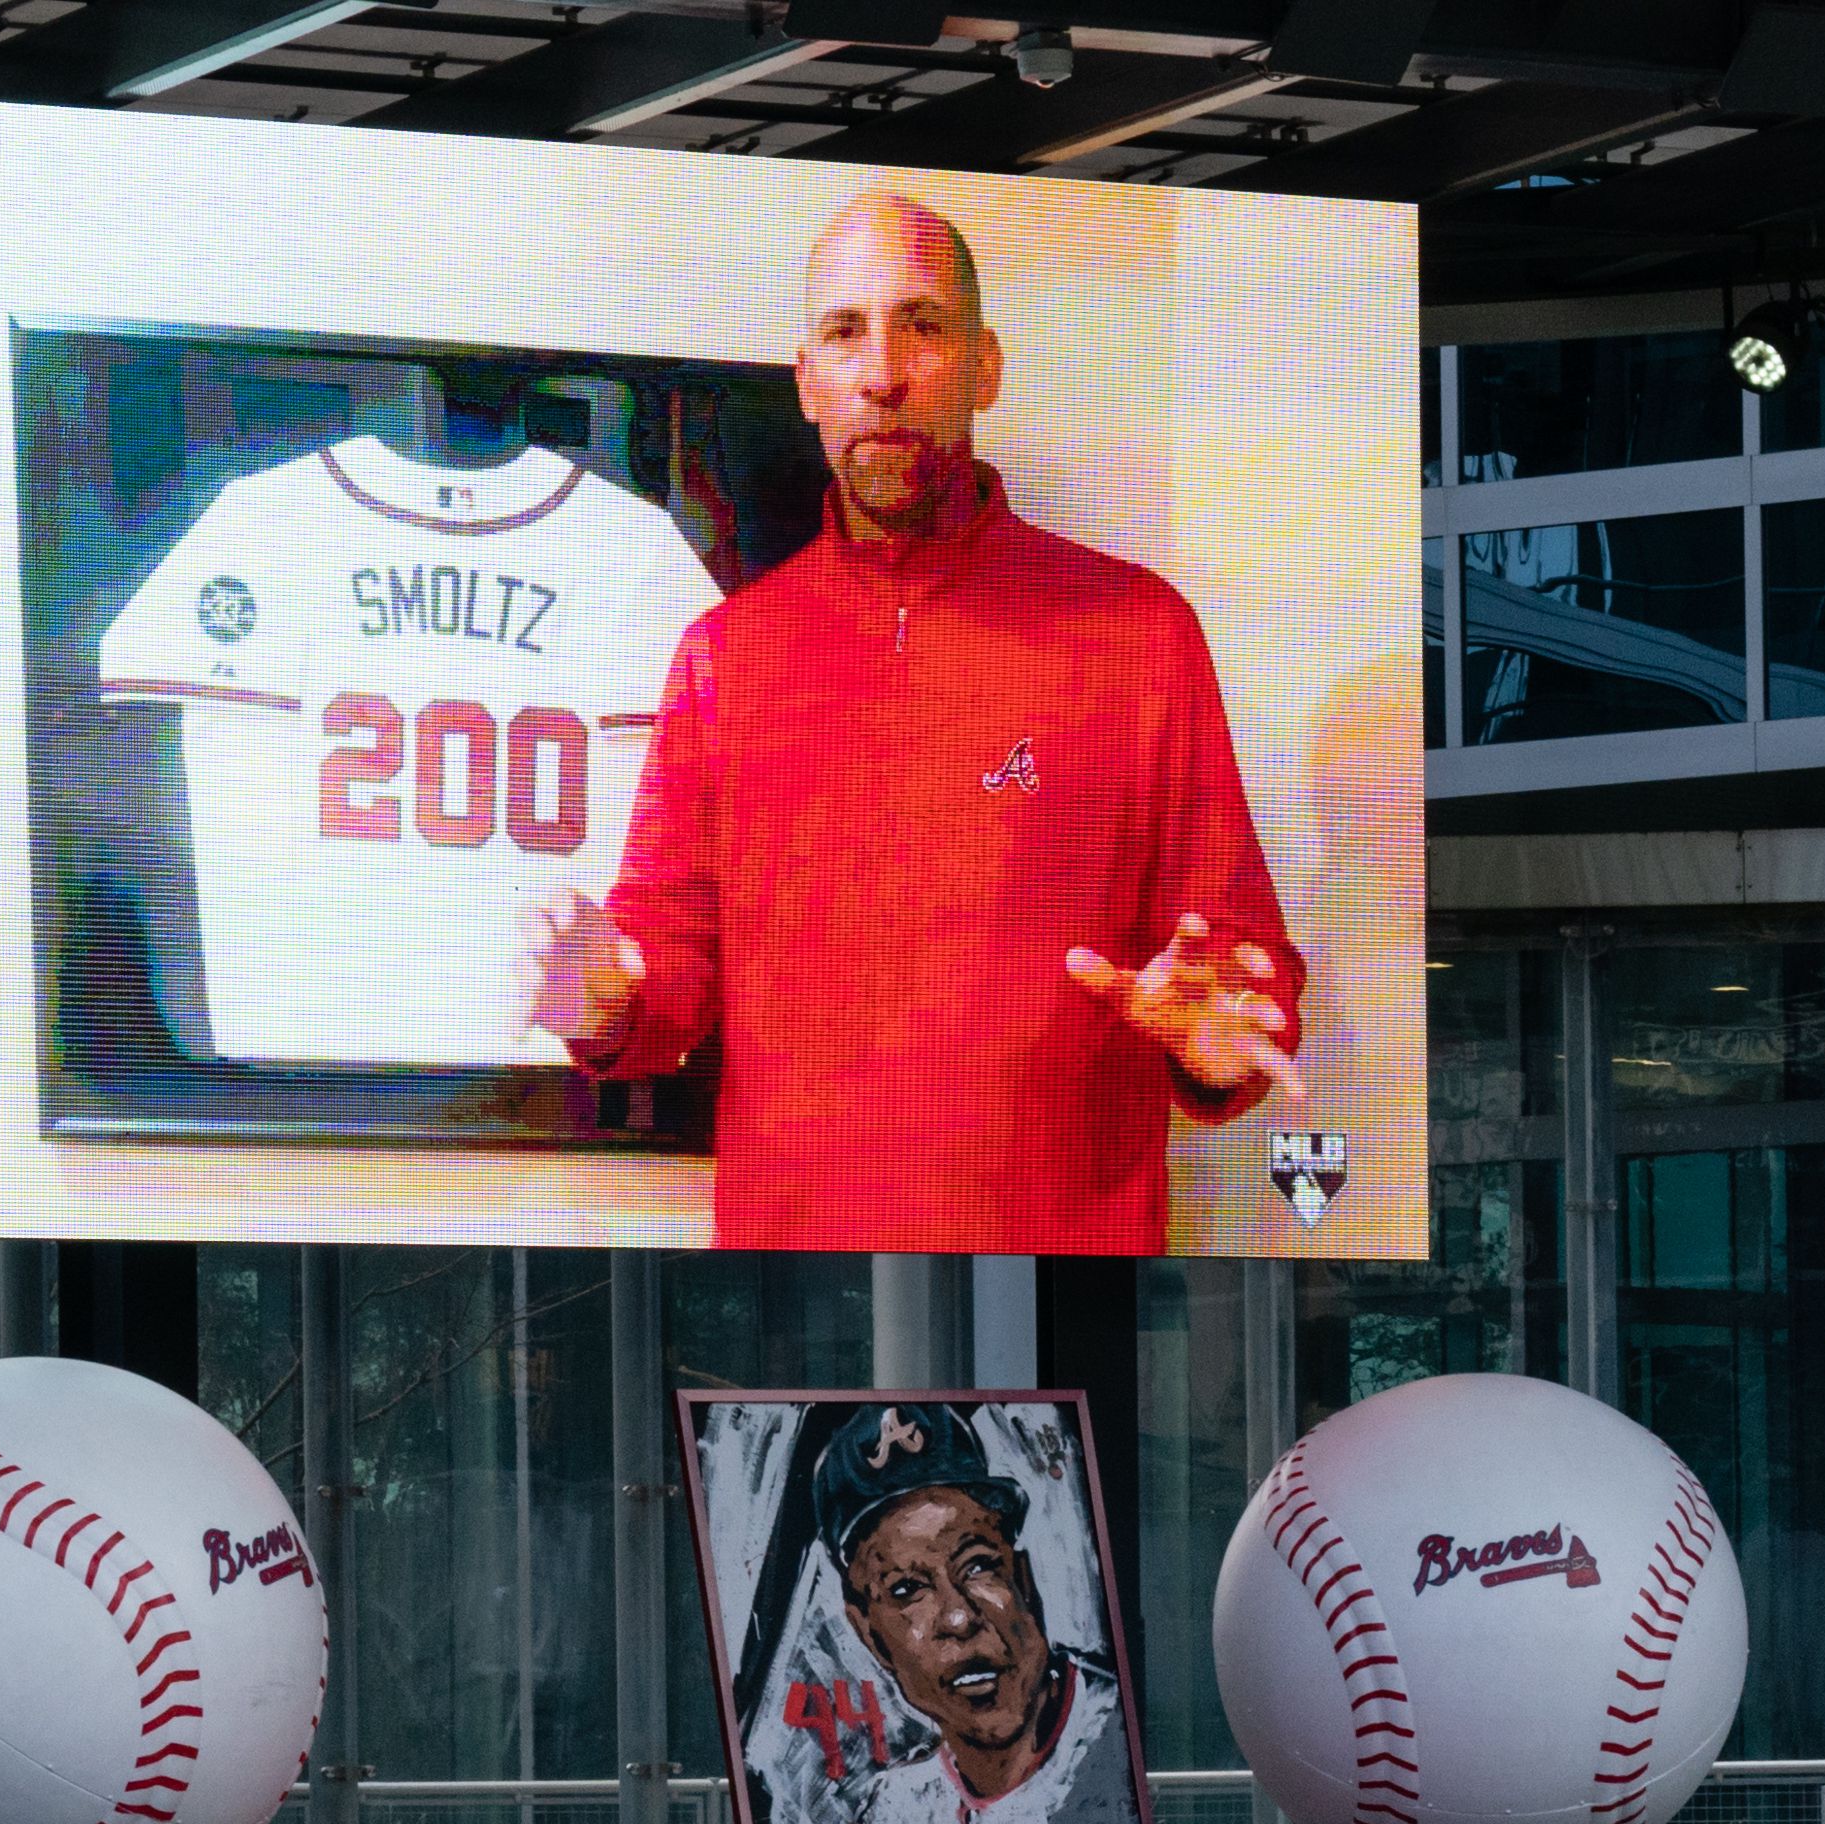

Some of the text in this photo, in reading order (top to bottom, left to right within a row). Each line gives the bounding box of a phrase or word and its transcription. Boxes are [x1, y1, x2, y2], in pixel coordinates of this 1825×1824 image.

[352, 564, 557, 653] SMOLTZ
[318, 692, 589, 855] 200
[867, 1407, 924, 1469] A
[1412, 1522, 1564, 1598] Braves
[783, 1679, 890, 1781] 44
